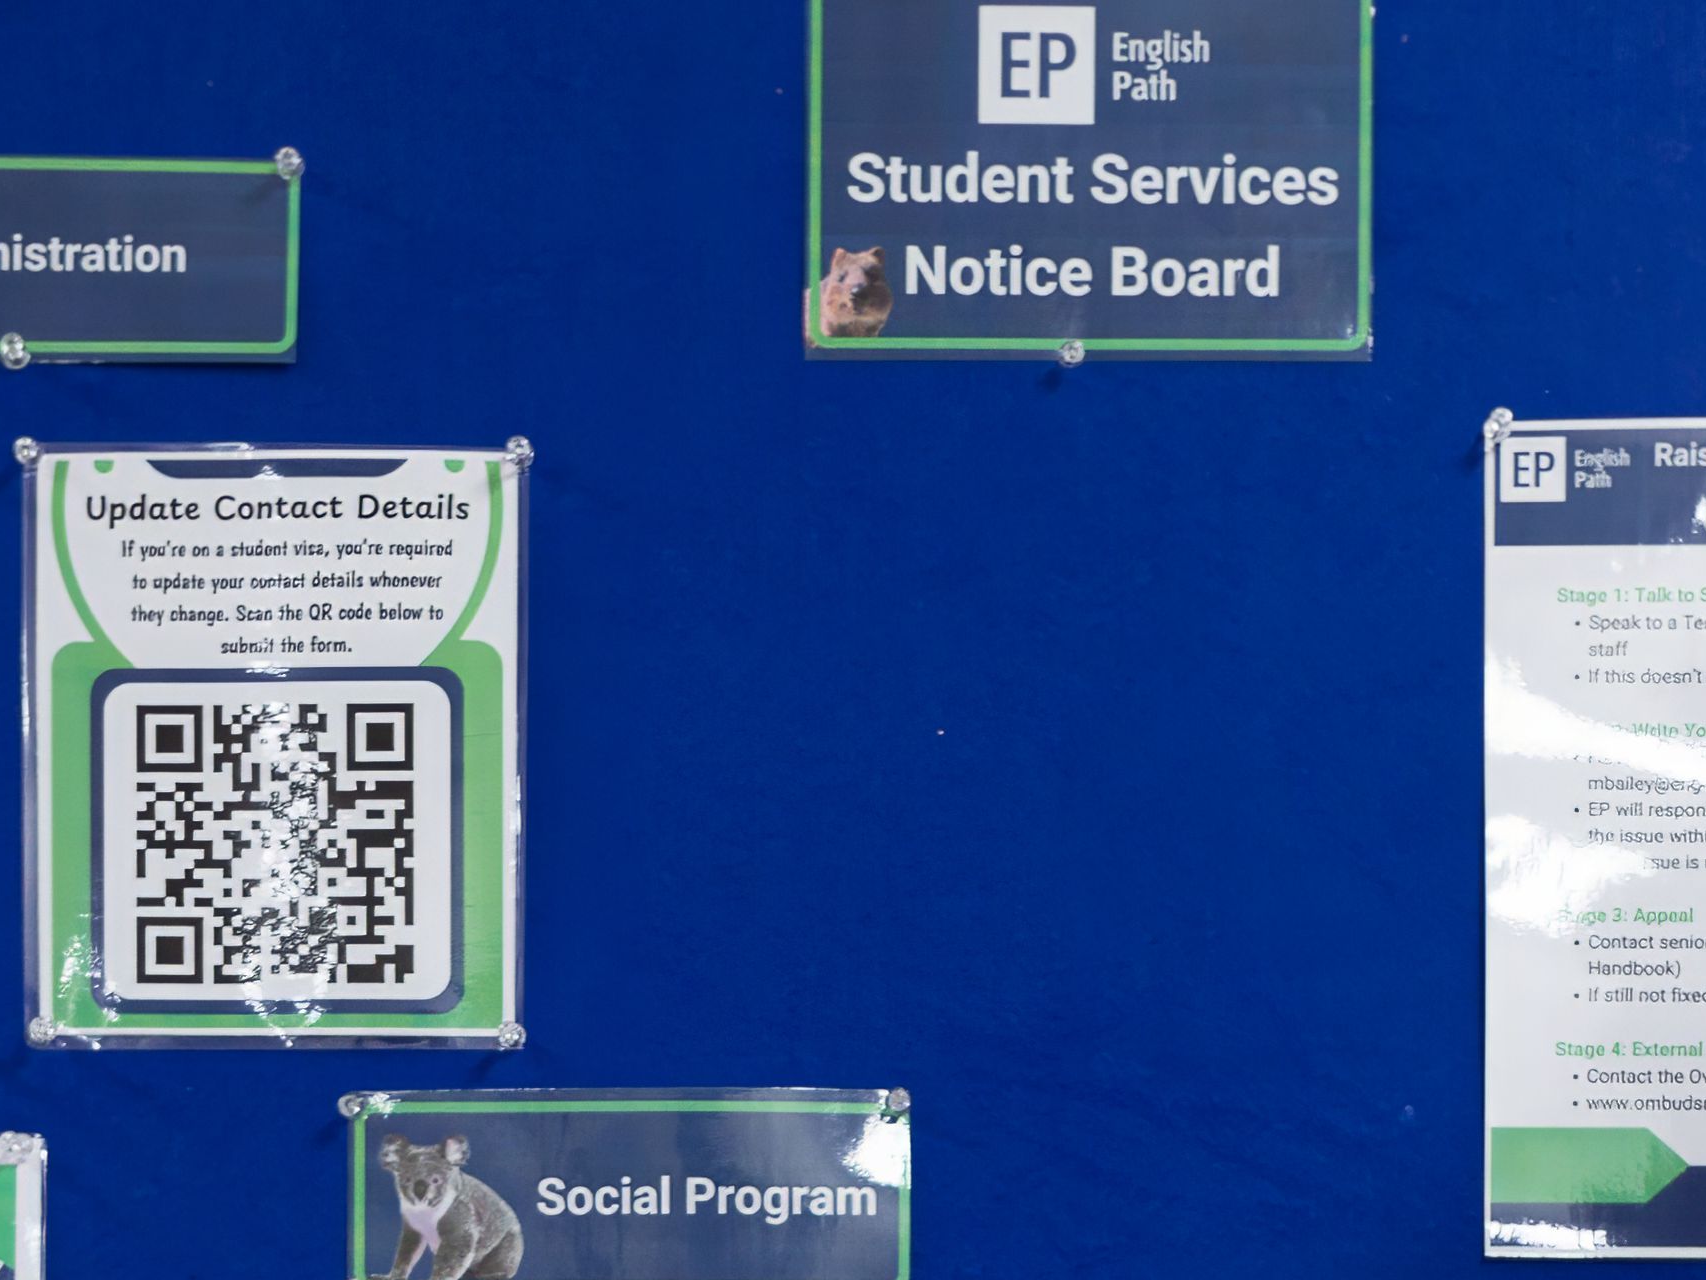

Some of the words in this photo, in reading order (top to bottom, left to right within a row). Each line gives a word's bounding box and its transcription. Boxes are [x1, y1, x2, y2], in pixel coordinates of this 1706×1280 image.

[1000, 31, 1077, 99] EP
[1112, 30, 1210, 71] English
[1112, 70, 1177, 101] Path
[847, 150, 1074, 204] Student
[1090, 153, 1339, 206] Services
[905, 244, 1093, 297] Notice
[1111, 244, 1280, 297] Board
[1513, 451, 1555, 488] EP
[1574, 447, 1631, 471] English
[1574, 471, 1613, 489] Path
[86, 493, 201, 530] Update
[214, 495, 343, 521] Contact
[357, 493, 470, 520] Details
[1556, 1041, 1605, 1059] Stage
[1611, 1041, 1626, 1057] 4:
[1632, 1041, 1703, 1057] External
[1587, 1068, 1653, 1084] Contact
[1657, 1069, 1684, 1084] the
[537, 1175, 670, 1216] Social
[686, 1176, 877, 1225] Program
